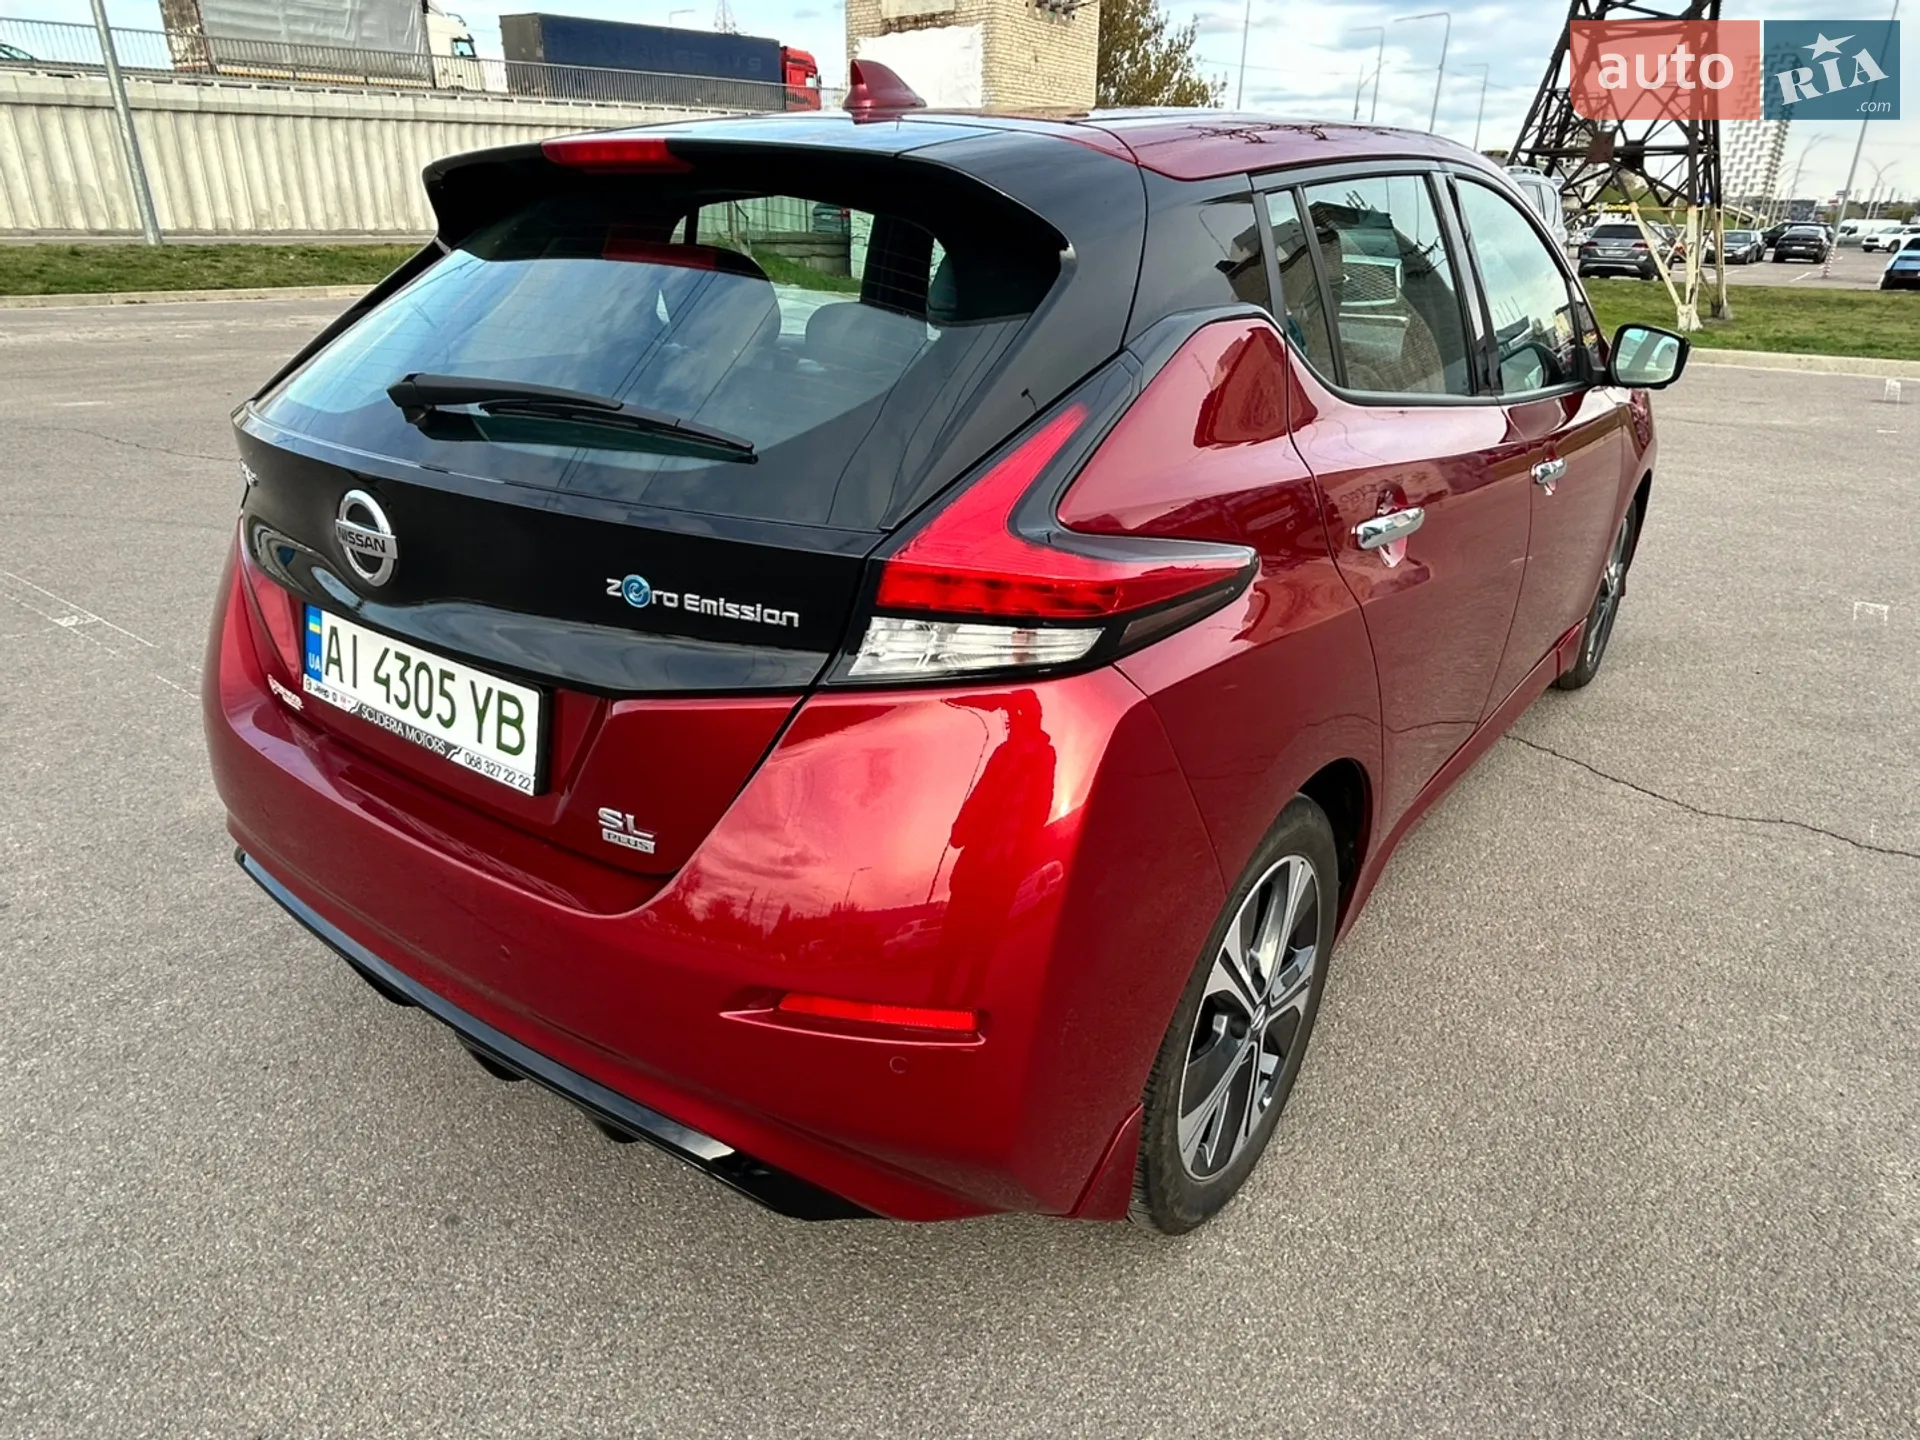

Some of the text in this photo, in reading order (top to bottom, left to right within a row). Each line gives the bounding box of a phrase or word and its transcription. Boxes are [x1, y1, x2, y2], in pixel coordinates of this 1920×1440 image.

[338, 526, 386, 553] NISSAN
[684, 593, 799, 627] Emission
[308, 651, 321, 672] UA
[325, 625, 358, 689] AI
[374, 646, 457, 729] 4305
[469, 679, 526, 756] YB
[360, 705, 446, 755] SCUDERIA MOTORS
[464, 752, 532, 791] 068 327 22 22
[598, 807, 655, 838] SL
[605, 830, 650, 851] PLUS
